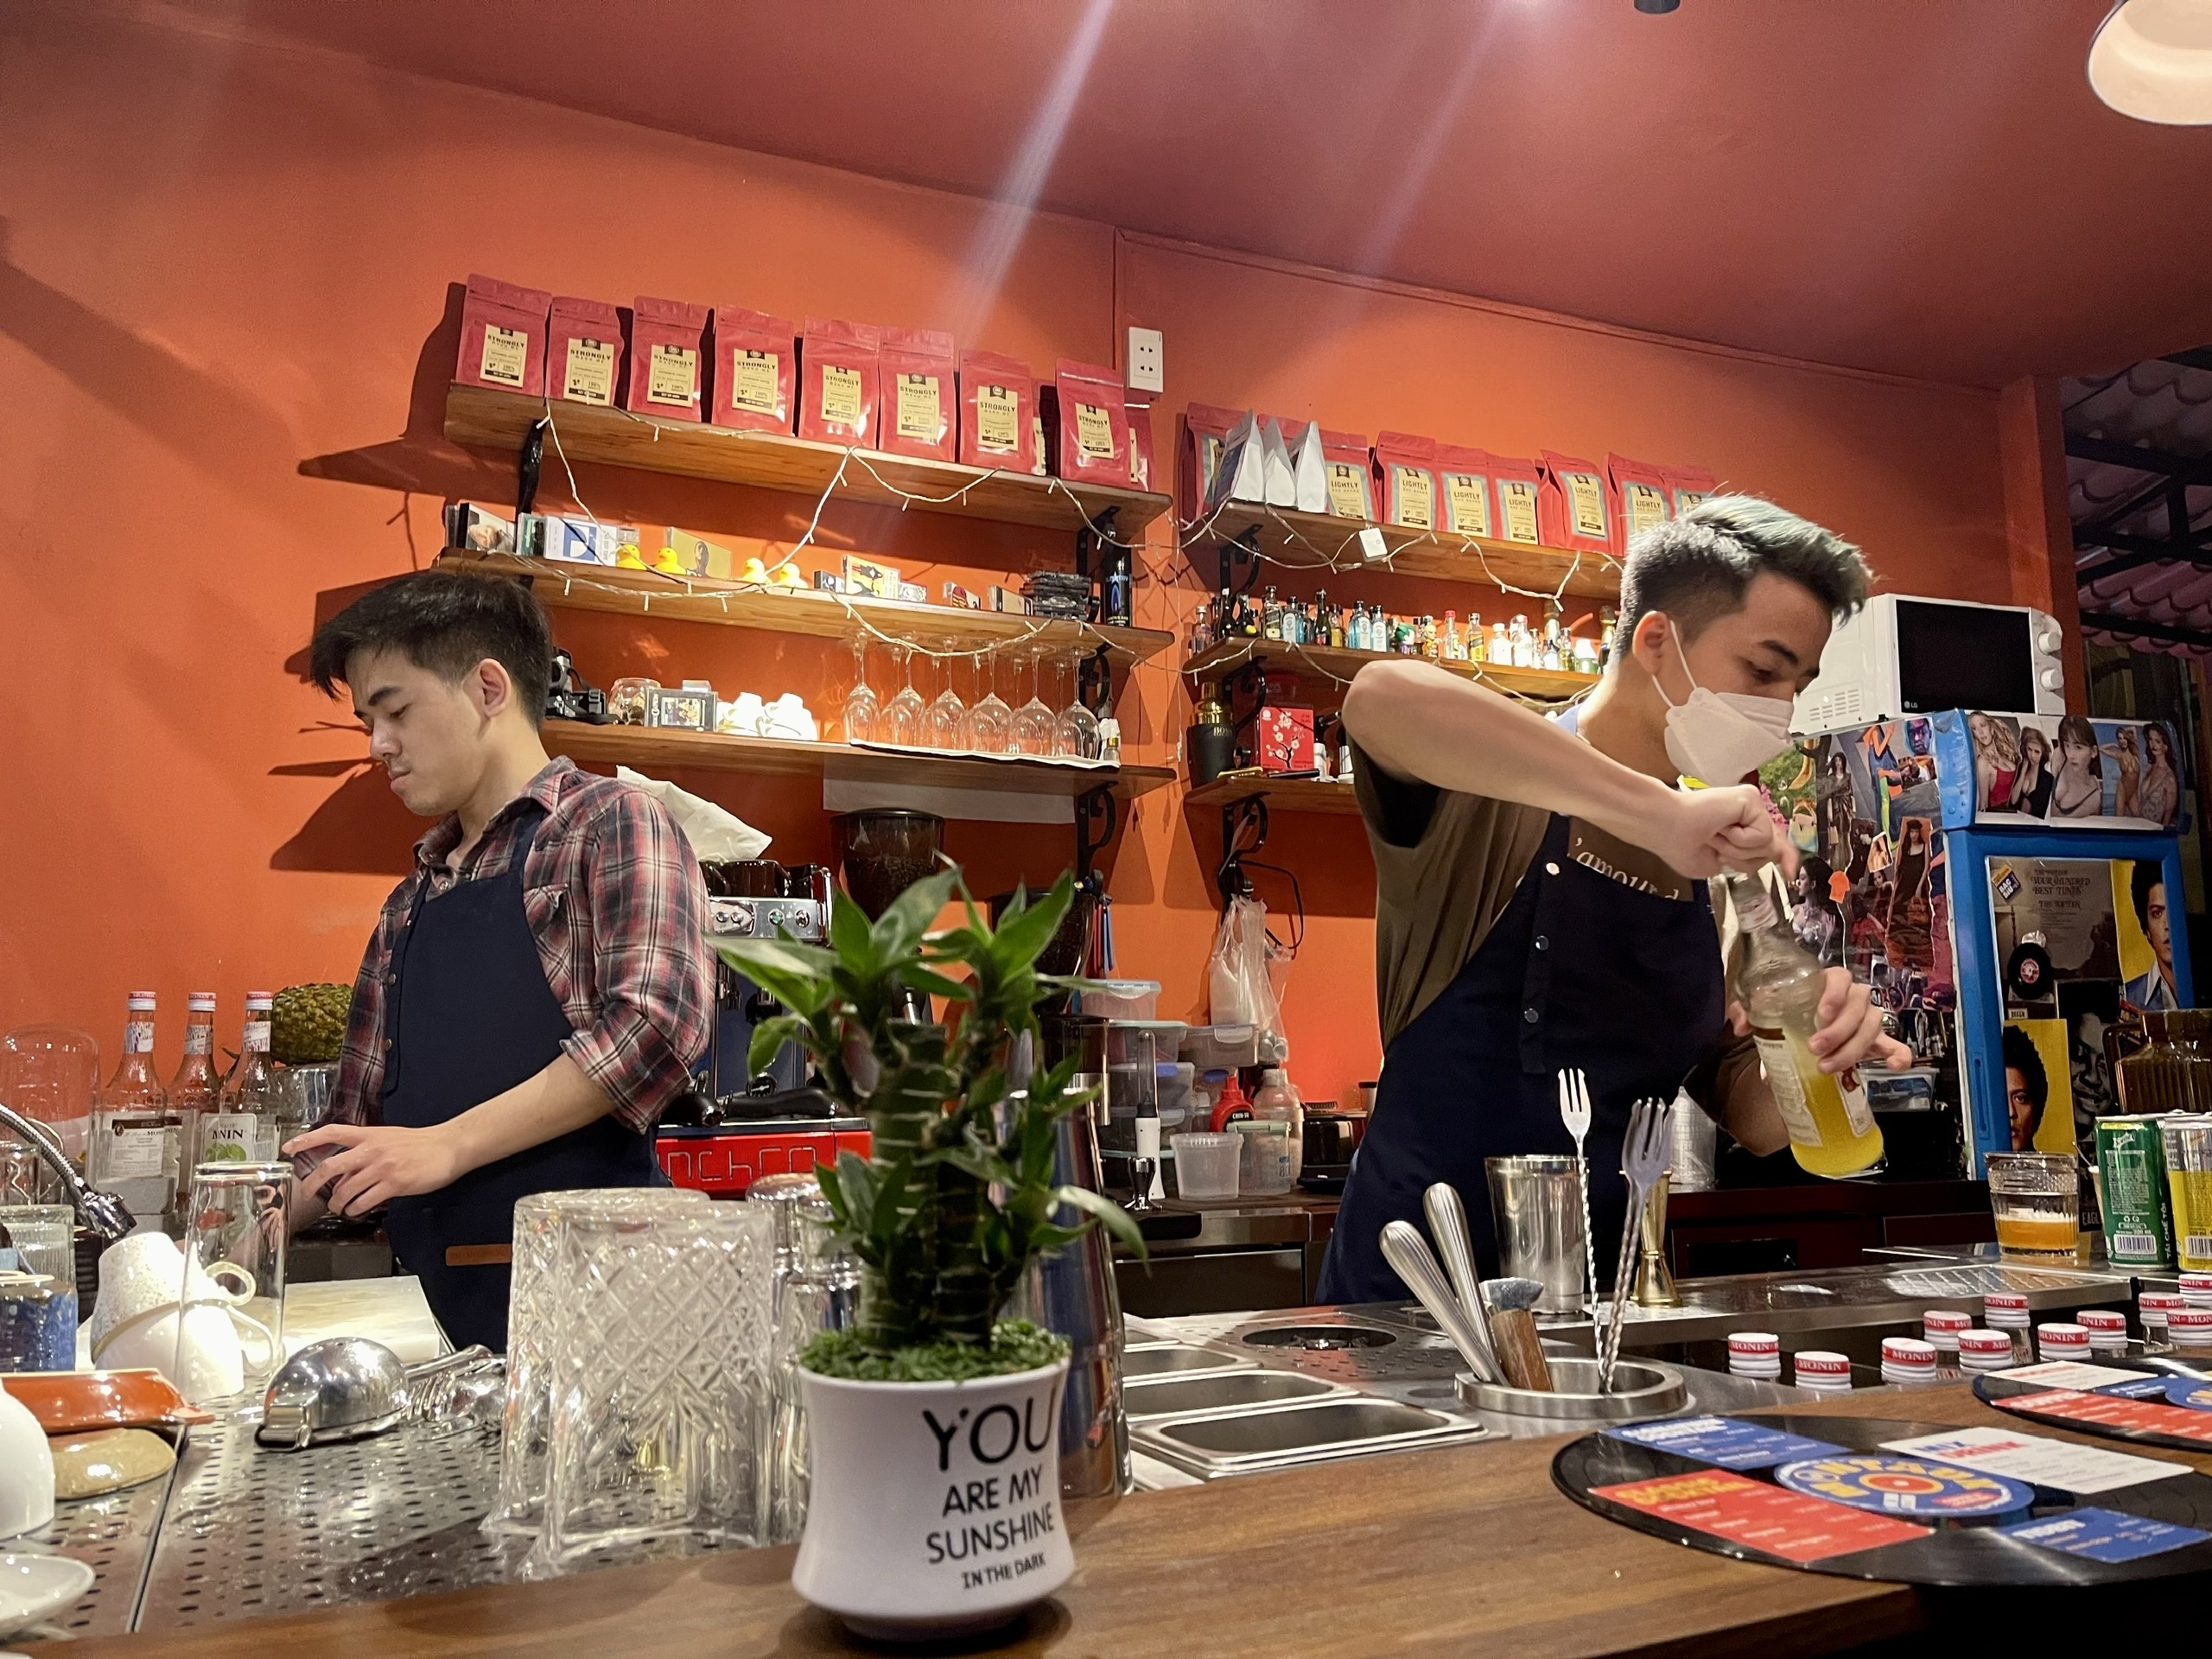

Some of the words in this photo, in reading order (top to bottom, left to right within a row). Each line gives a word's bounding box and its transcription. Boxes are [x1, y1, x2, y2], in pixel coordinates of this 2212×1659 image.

[487, 334, 524, 347] STRONGLY
[570, 349, 611, 360] STRONGLY
[654, 354, 693, 366] STRONGLY
[737, 361, 776, 370] STRONGLY
[825, 375, 860, 386] STRONGLY
[900, 386, 937, 396] STRONGLY
[980, 402, 1015, 412] STRONGLY
[1078, 415, 1108, 425] STRONGLY
[1402, 480, 1427, 490] LIGHTLY
[1453, 492, 1480, 500] LIGHTLY
[1575, 487, 1598, 497] LIGHTLY
[1509, 499, 1532, 508] LIGHTLY
[1636, 499, 1661, 508] LIGHTLY
[2082, 1211, 2100, 1225] EAGL
[2188, 1314, 2212, 1323] MON
[1731, 1341, 1770, 1351] MONIN
[1892, 1351, 1934, 1362] MONIN
[1798, 1360, 1841, 1370] MONIN
[922, 1385, 1058, 1471] YOU
[943, 1478, 1000, 1518] ARE
[1008, 1464, 1043, 1504] MY
[926, 1501, 1054, 1565] SUNSHINE
[963, 1571, 983, 1590] IN
[984, 1565, 1013, 1583] THE
[1015, 1553, 1046, 1575] DARK
